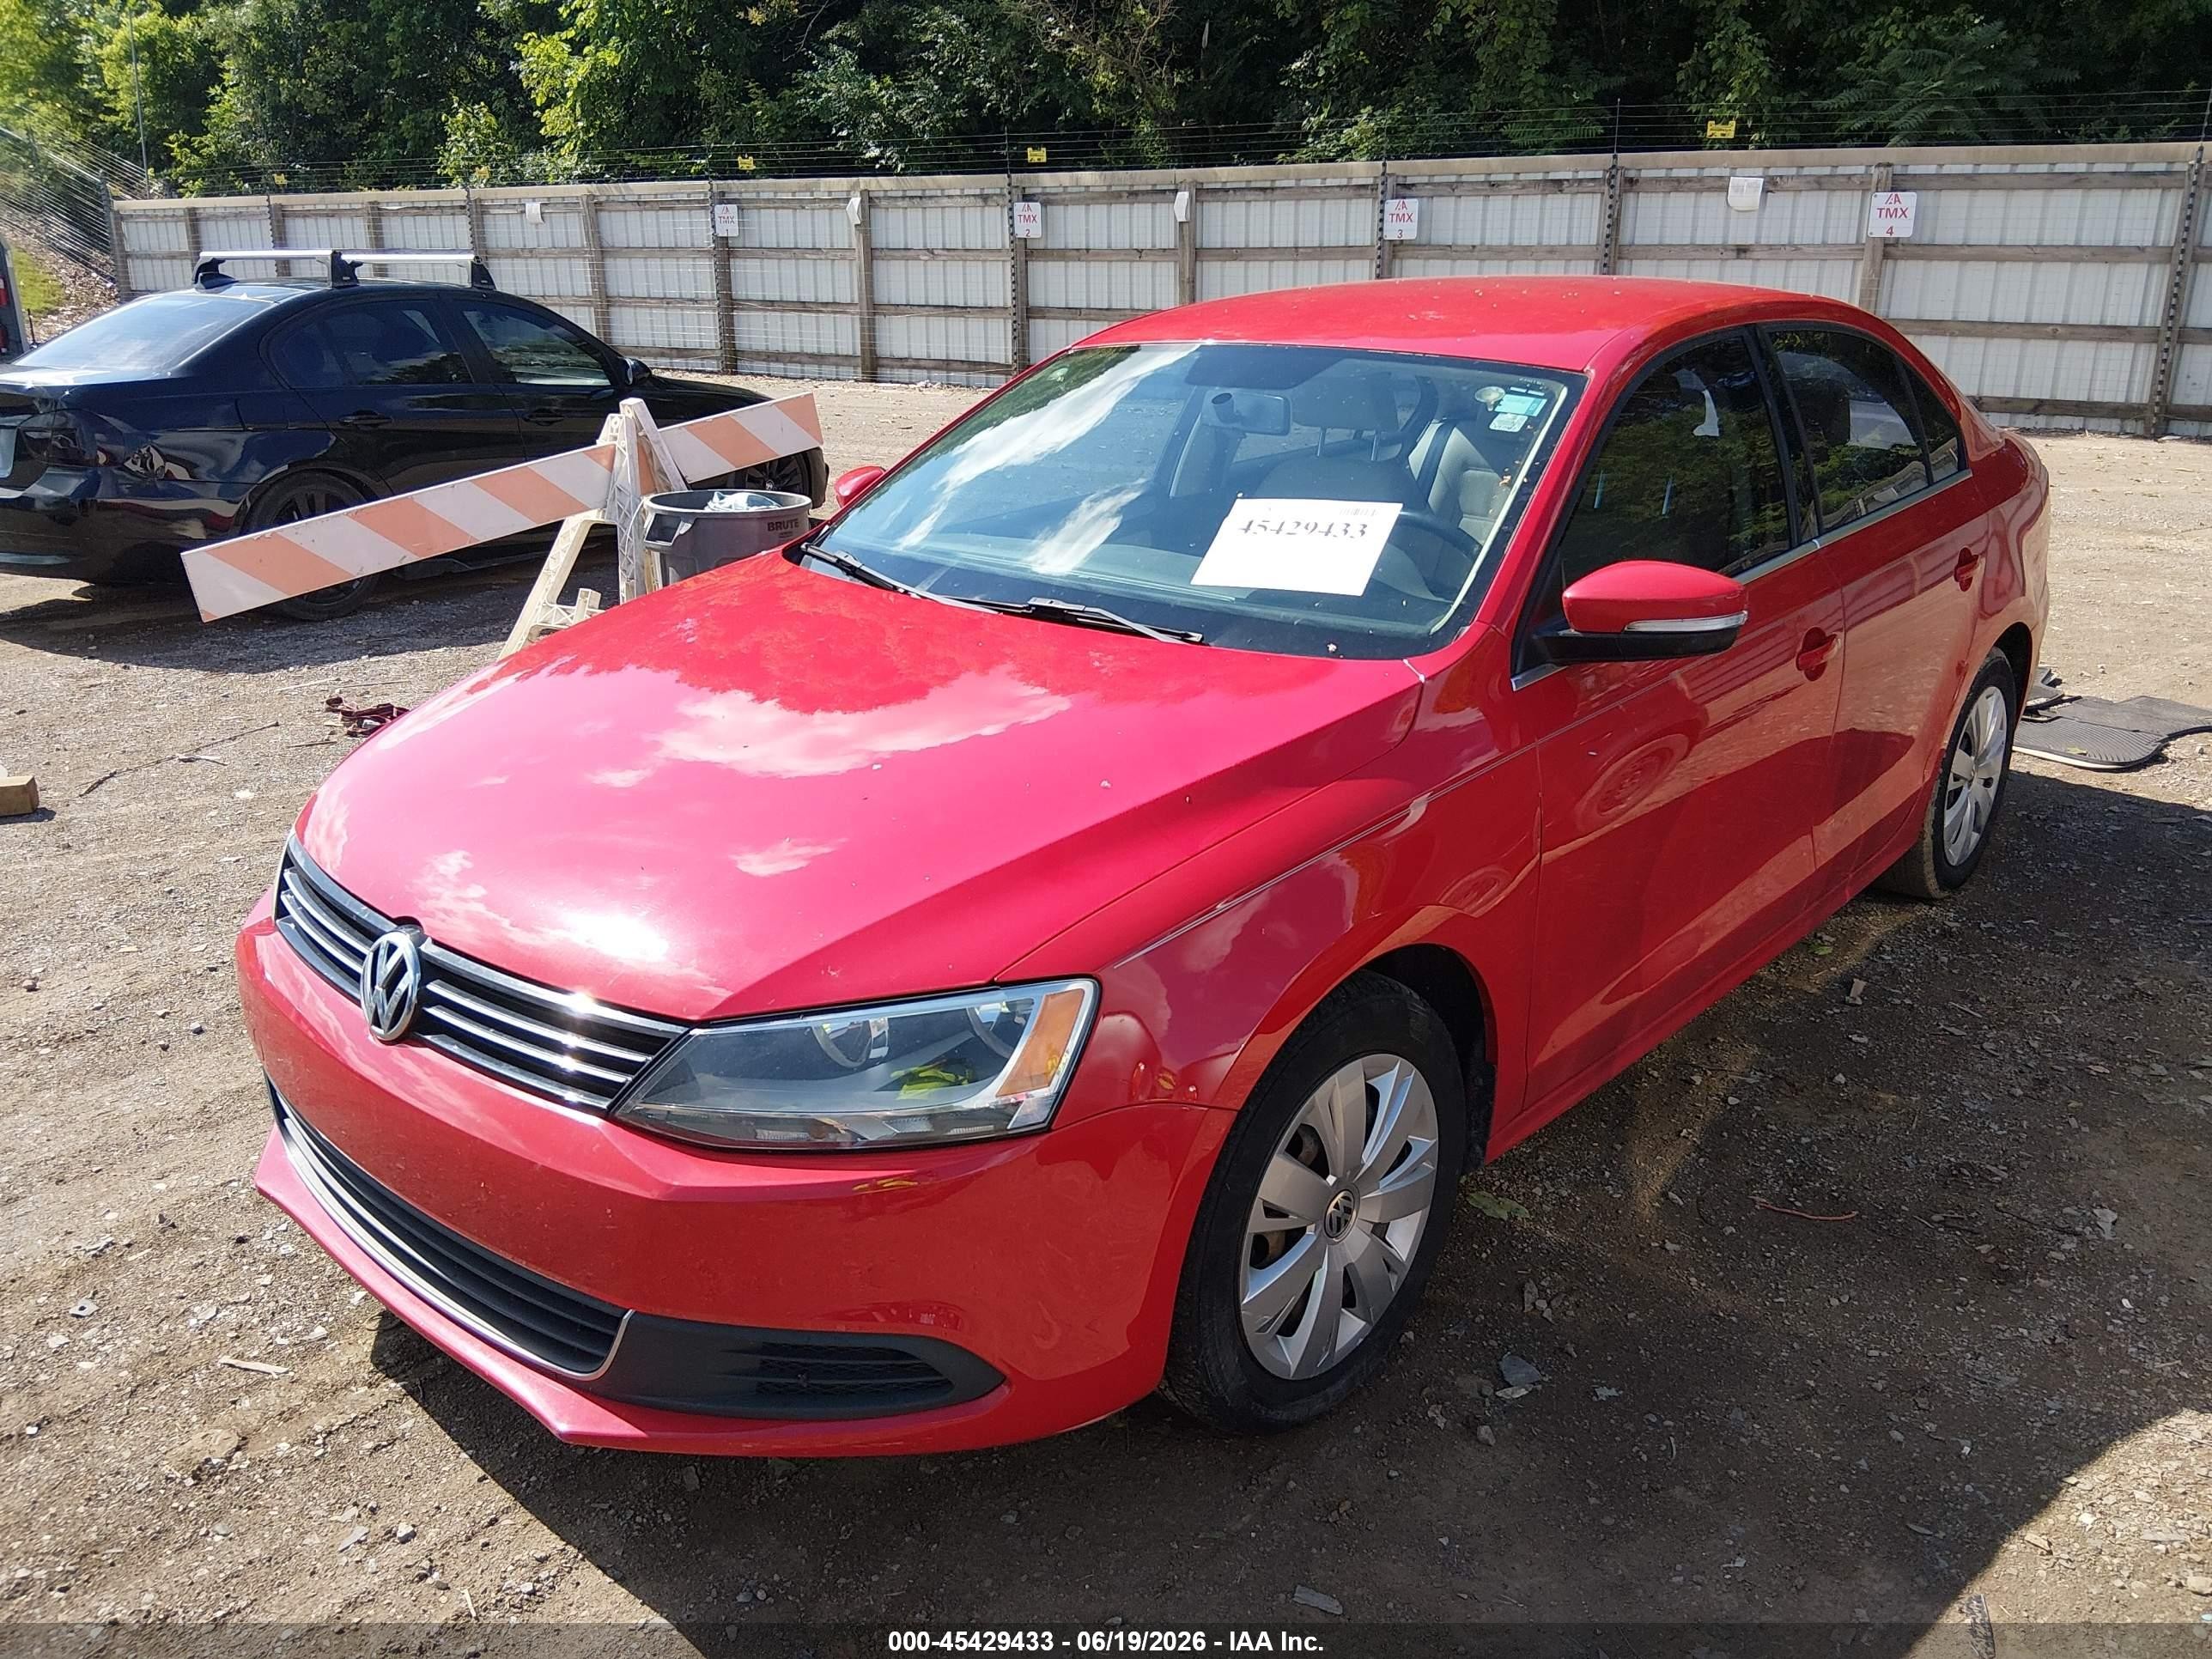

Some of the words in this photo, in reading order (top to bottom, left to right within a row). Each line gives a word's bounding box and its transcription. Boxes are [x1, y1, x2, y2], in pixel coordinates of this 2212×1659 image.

[1389, 212, 1413, 223] TMX
[1876, 207, 1909, 219] TMX
[718, 216, 735, 224] TMX
[1018, 214, 1037, 224] TMX
[1025, 228, 1031, 237] 2
[1397, 229, 1403, 239] 3
[1886, 226, 1894, 236] 4
[767, 519, 799, 532] BRUTE
[1238, 519, 1369, 539] 45429433
